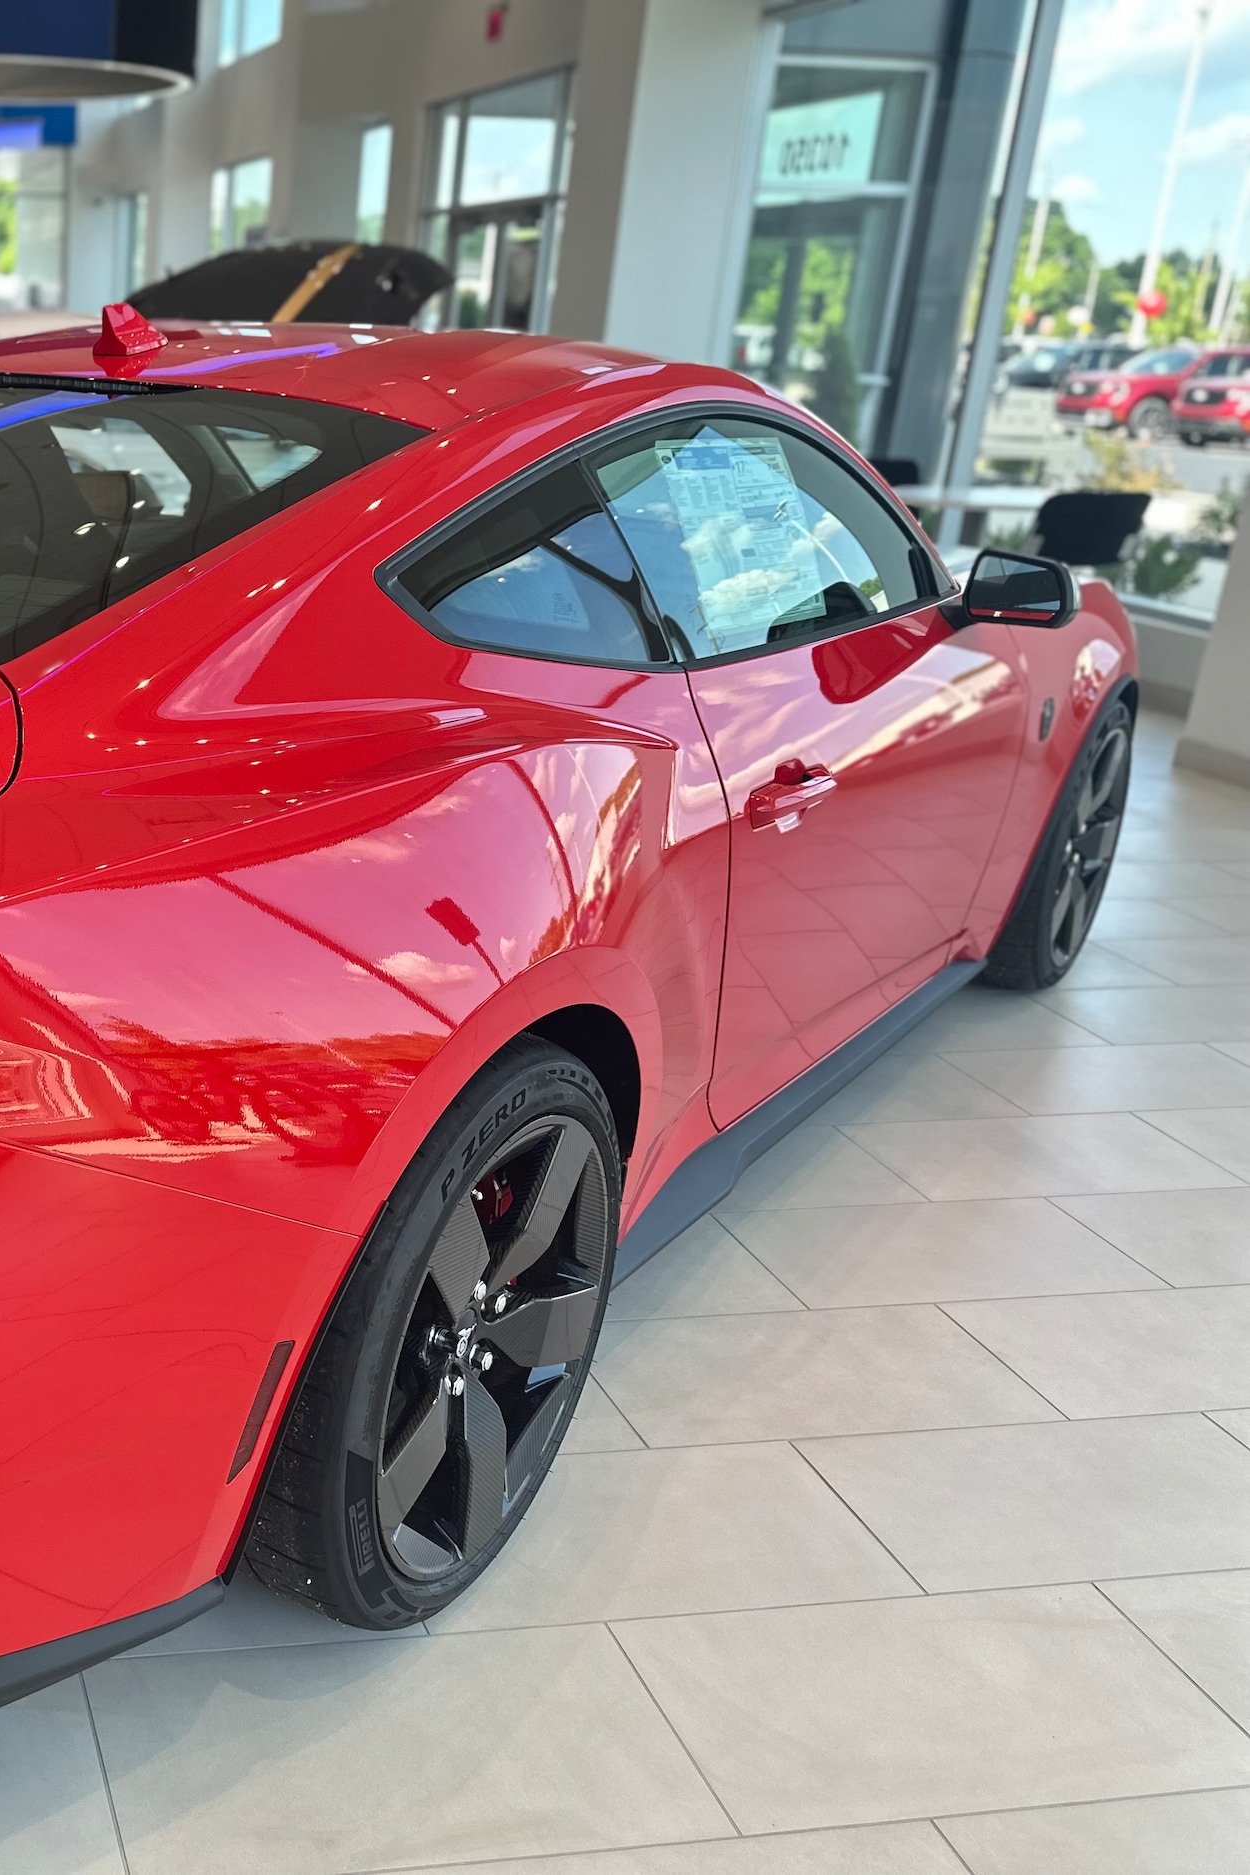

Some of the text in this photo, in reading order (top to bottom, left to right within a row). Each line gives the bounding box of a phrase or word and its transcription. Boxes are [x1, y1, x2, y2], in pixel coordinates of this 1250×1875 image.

[441, 1087, 526, 1203] P ZERO
[349, 1497, 375, 1577] PIRELLI
